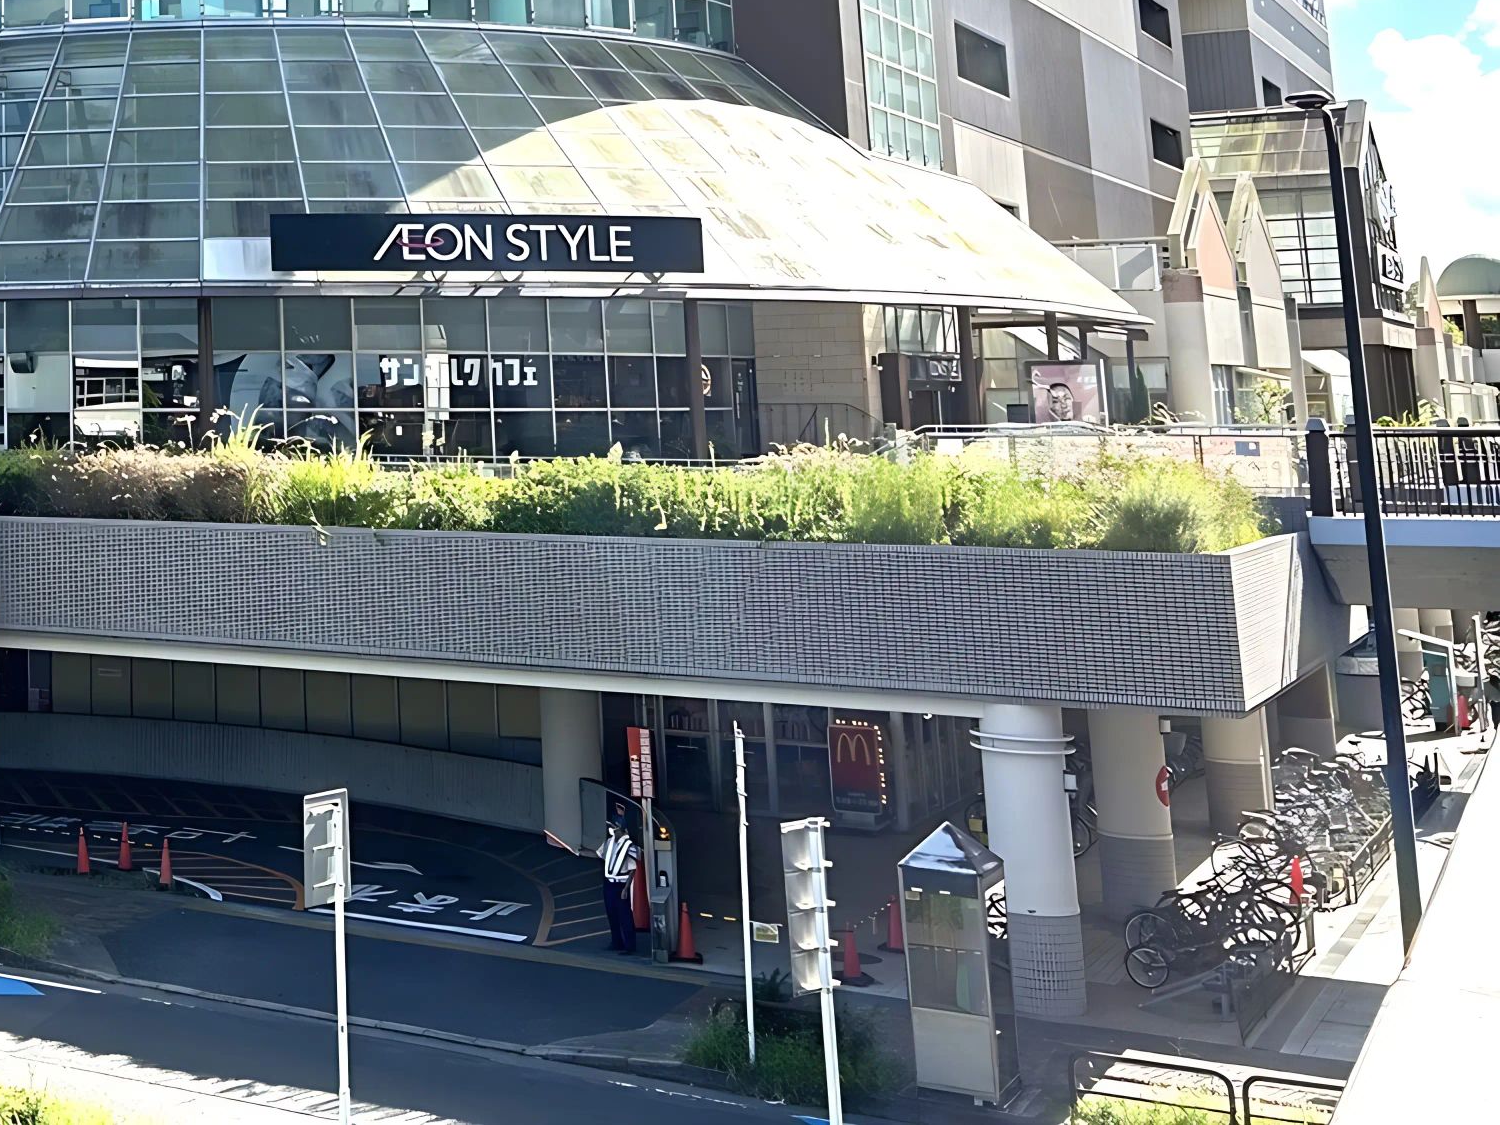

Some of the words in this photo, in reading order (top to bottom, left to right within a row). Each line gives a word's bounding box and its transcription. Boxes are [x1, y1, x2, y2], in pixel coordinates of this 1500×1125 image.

[506, 223, 634, 262] STYLE
[379, 357, 539, 388] サンルクカフェ
